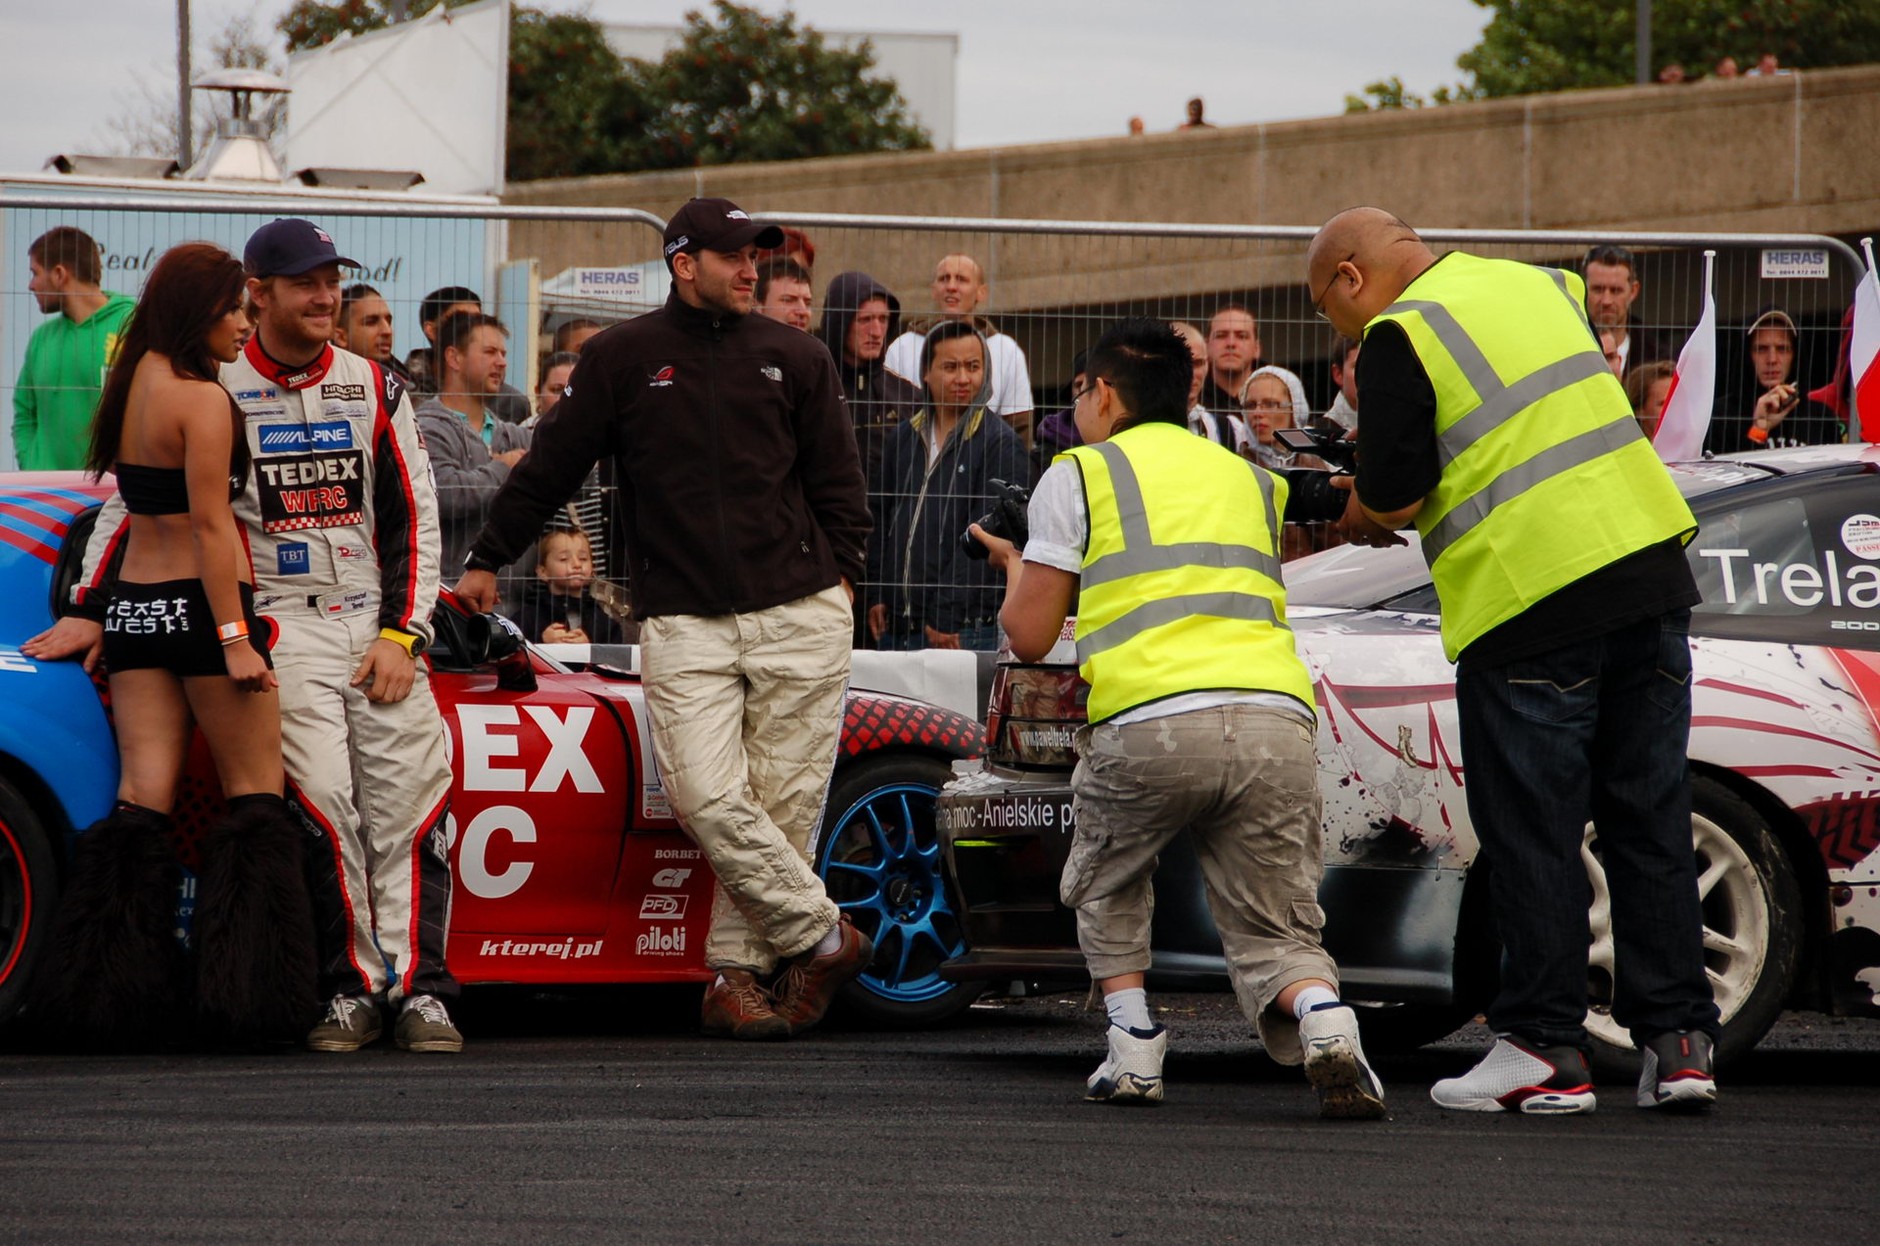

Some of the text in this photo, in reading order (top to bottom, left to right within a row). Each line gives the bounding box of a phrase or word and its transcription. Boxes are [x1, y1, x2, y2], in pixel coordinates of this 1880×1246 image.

[1768, 252, 1824, 265] HERAS
[344, 257, 402, 282] ood!
[581, 272, 639, 284] HERAS
[325, 385, 362, 394] HITACHI
[291, 428, 349, 443] ALPINE
[261, 458, 358, 486] TEDEX
[281, 549, 306, 561] TBT
[1700, 549, 1880, 609] Trela
[105, 614, 175, 634] WEST
[443, 703, 605, 793] EX
[1019, 726, 1077, 753] www.paweltrela.p
[654, 850, 701, 859] BORBET
[643, 900, 678, 911] PFD
[479, 937, 604, 960] kterej.pl
[636, 926, 686, 955] piloti
